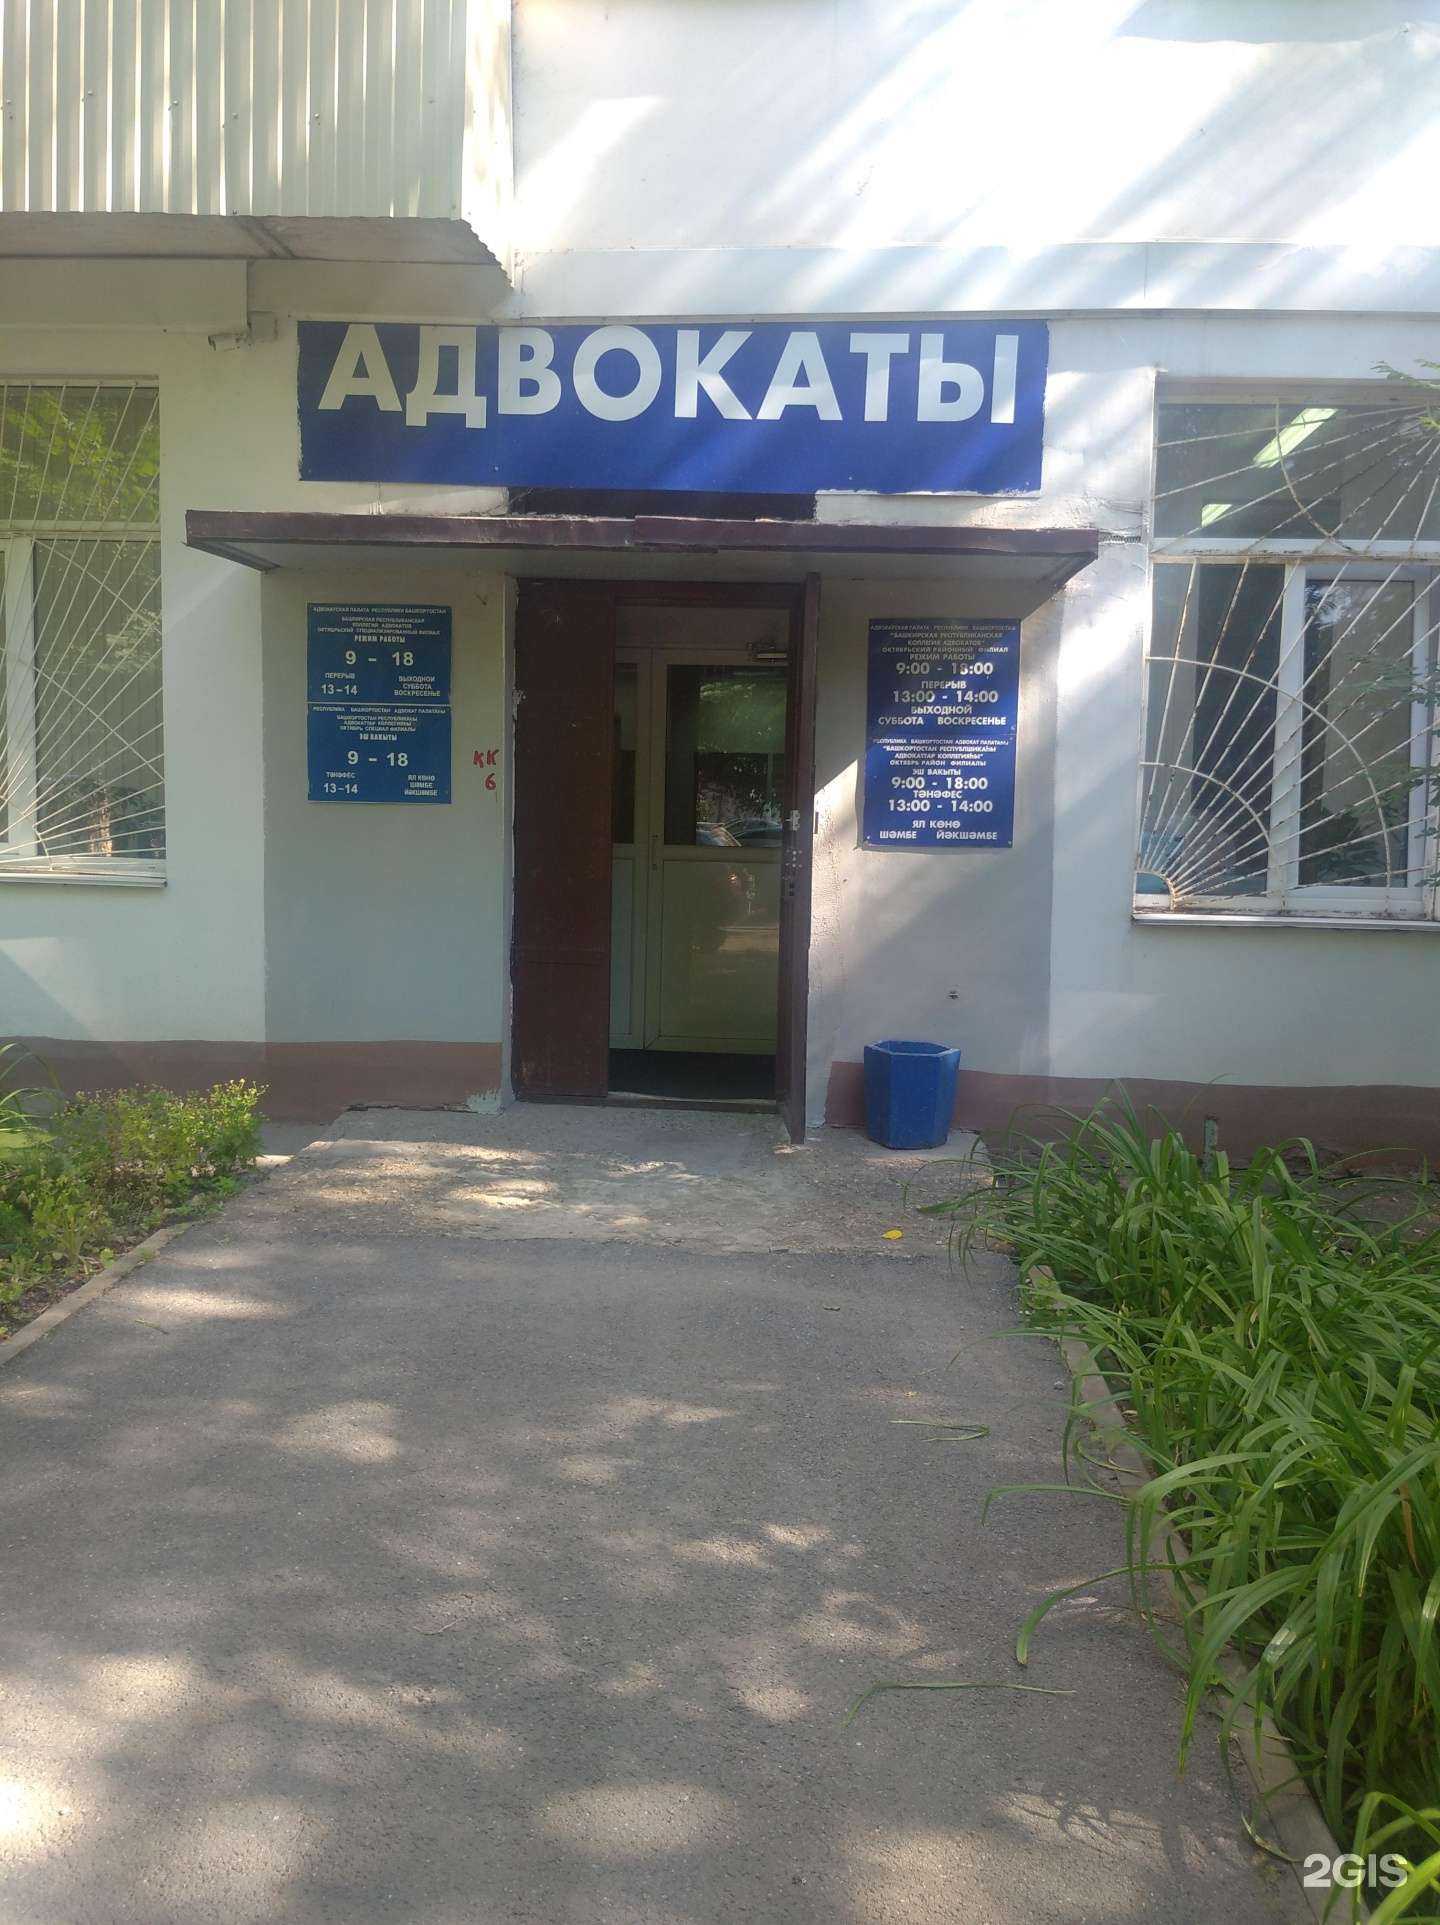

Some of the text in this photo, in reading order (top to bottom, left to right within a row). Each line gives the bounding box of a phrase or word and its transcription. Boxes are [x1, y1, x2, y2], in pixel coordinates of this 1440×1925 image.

[318, 324, 1018, 429] АДВОКАТЫ
[345, 650, 357, 665] 9
[391, 651, 414, 666] 18
[896, 663, 930, 675] 9:00
[952, 663, 993, 675] 18:00
[325, 672, 355, 680] ПЕРЕРЫВ
[922, 681, 967, 689] ПЕРЕРЫВ
[394, 689, 441, 697] ВОСКРЕСЕНЬЕ
[893, 691, 935, 703] 13:00
[956, 691, 998, 703] 14:00
[912, 705, 972, 716] ВЫХОДНОЙ
[878, 717, 1007, 725] СУББОТА ВОСКРЕСЕНЬЕ
[347, 750, 359, 765] 9
[386, 752, 409, 767] 18
[484, 772, 497, 791] 6
[891, 777, 925, 789] 9:00
[946, 777, 988, 789] 18:00
[889, 800, 930, 812] 13:00
[952, 800, 993, 812] 14:00
